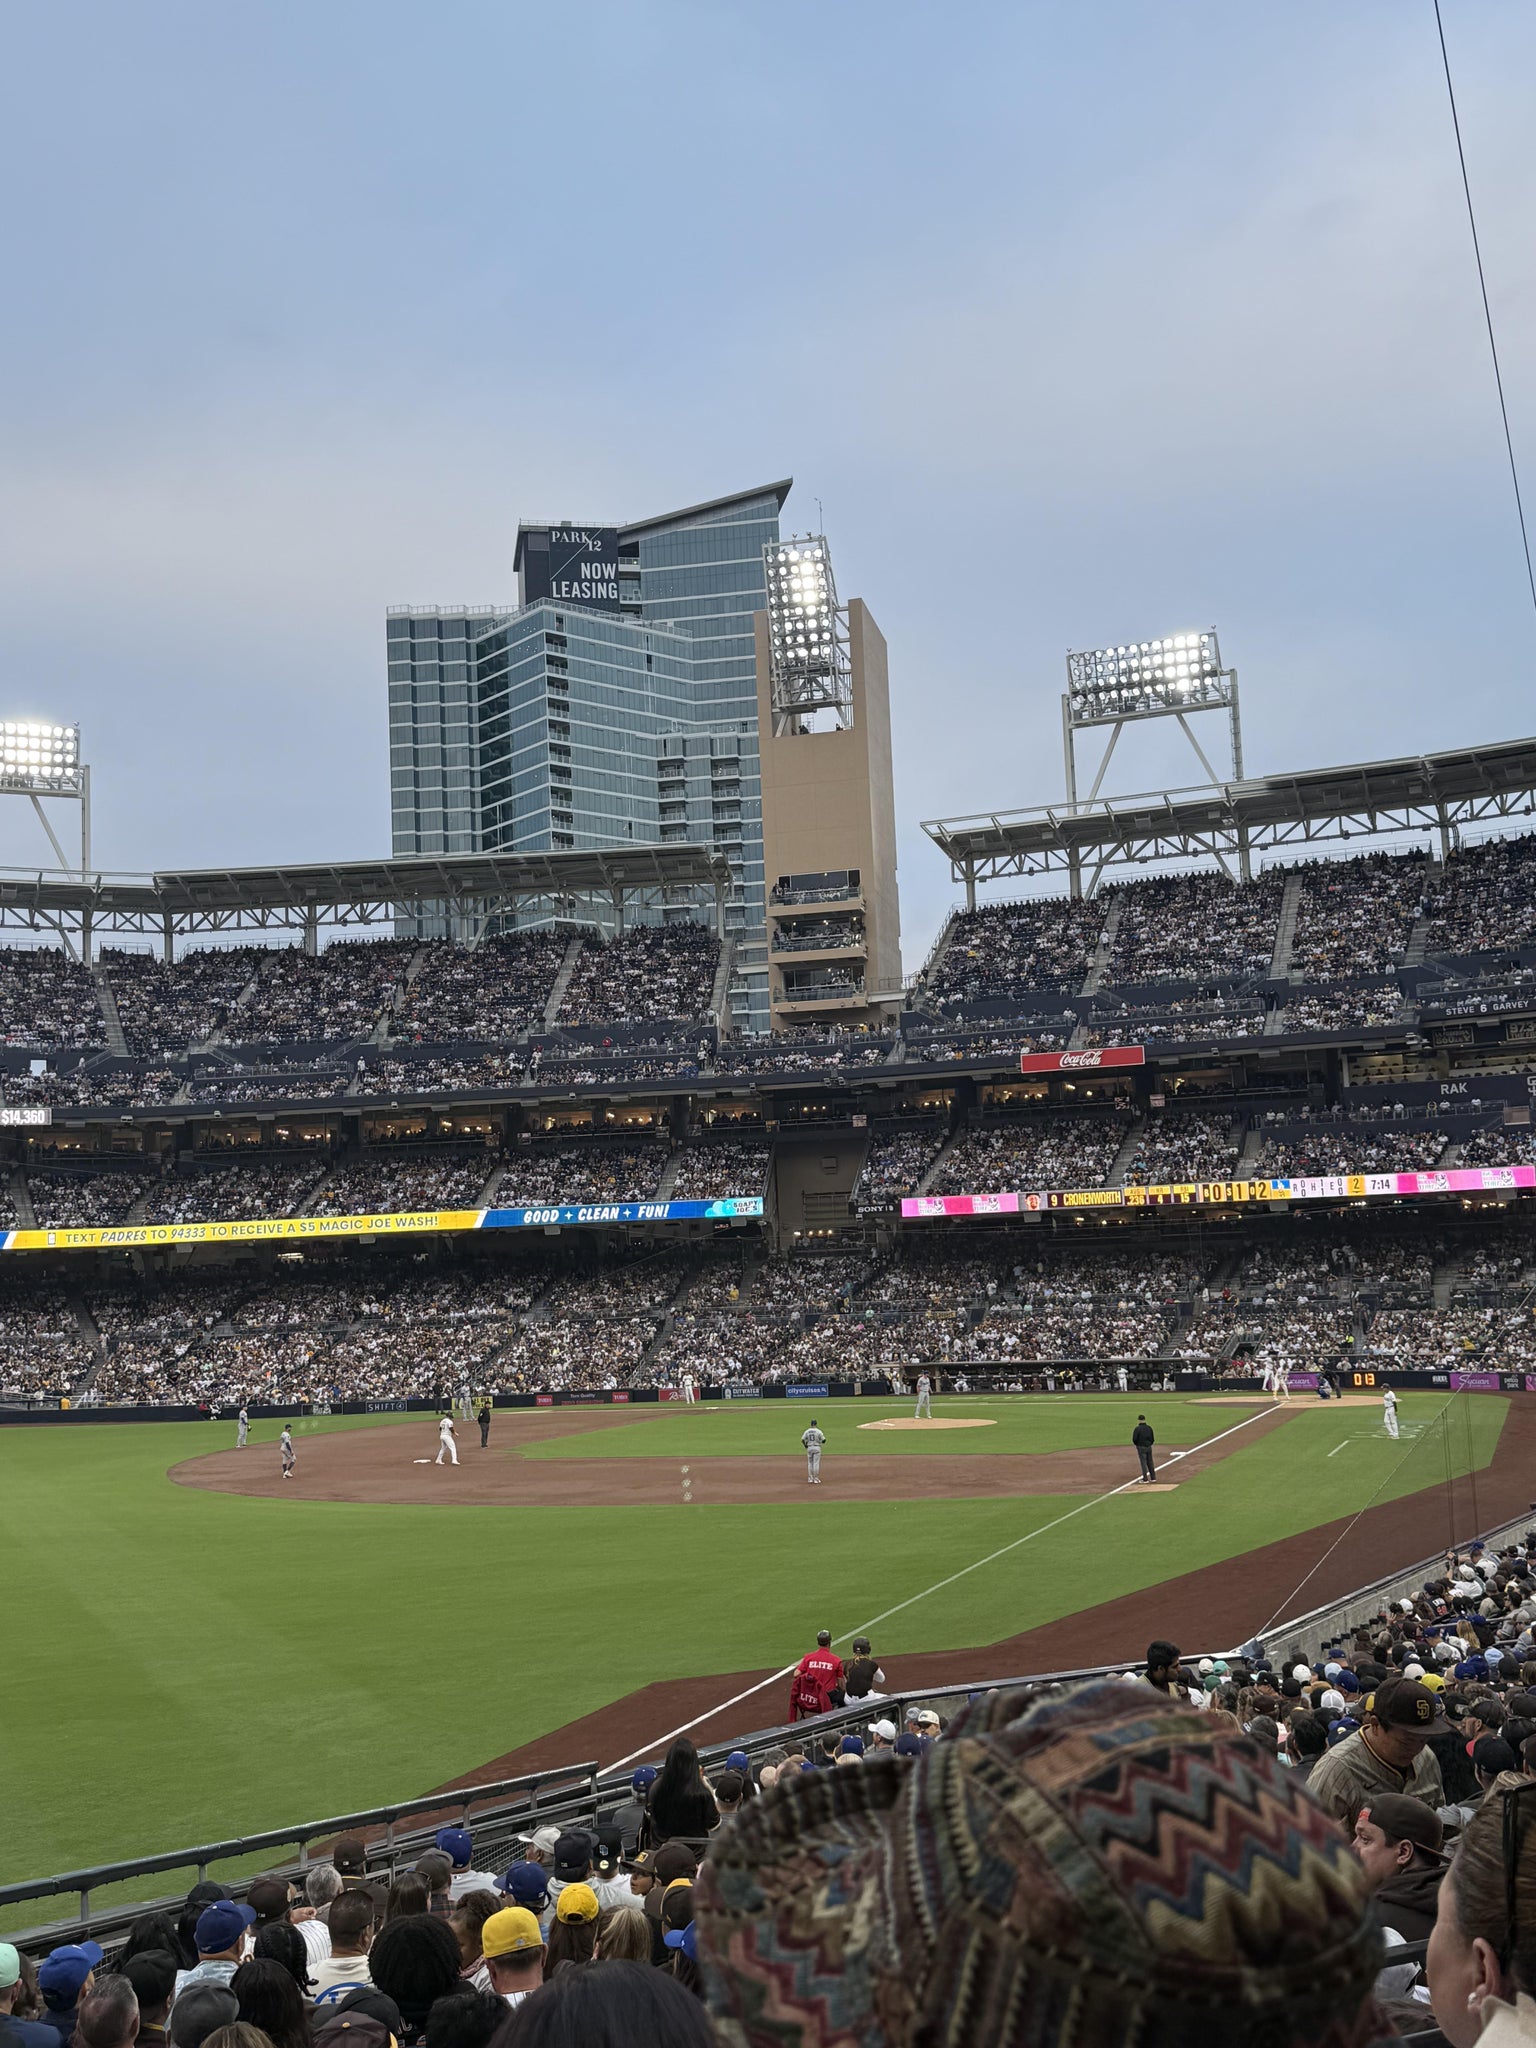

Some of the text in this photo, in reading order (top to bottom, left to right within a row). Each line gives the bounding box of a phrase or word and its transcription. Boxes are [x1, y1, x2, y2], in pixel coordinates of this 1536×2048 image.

[551, 531, 590, 543] PARK
[588, 540, 602, 551] 12
[581, 562, 616, 580] NOW
[552, 581, 618, 599] LEASING
[1446, 1000, 1529, 1016] STEVE 6 GARVEY
[1059, 1051, 1104, 1067] Coca-Cola
[1440, 1082, 1469, 1095] RAK
[1, 1109, 46, 1125] $14,360
[1293, 1183, 1298, 1192] R
[1311, 1182, 1316, 1191] H
[1330, 1182, 1335, 1191] E
[1353, 1178, 1360, 1189] 2
[1371, 1179, 1391, 1190] 7:14
[1204, 1187, 1210, 1198] B
[1212, 1184, 1220, 1200] 0
[1226, 1187, 1232, 1197] S
[1236, 1183, 1243, 1199] 1
[1258, 1181, 1268, 1198] 2
[1051, 1190, 1122, 1207] 9 CRONENWORTH
[1127, 1193, 1190, 1206] .236 4 15
[524, 1204, 670, 1223] GOOD CLEAN FUN!
[858, 1205, 884, 1213] SONY
[66, 1215, 439, 1243] TEXT PADRES TO 94333 TO RECEIVE A $5 MAGIC JOE WASH!
[368, 1403, 395, 1412] SHIFT
[808, 1661, 833, 1671] ELITE
